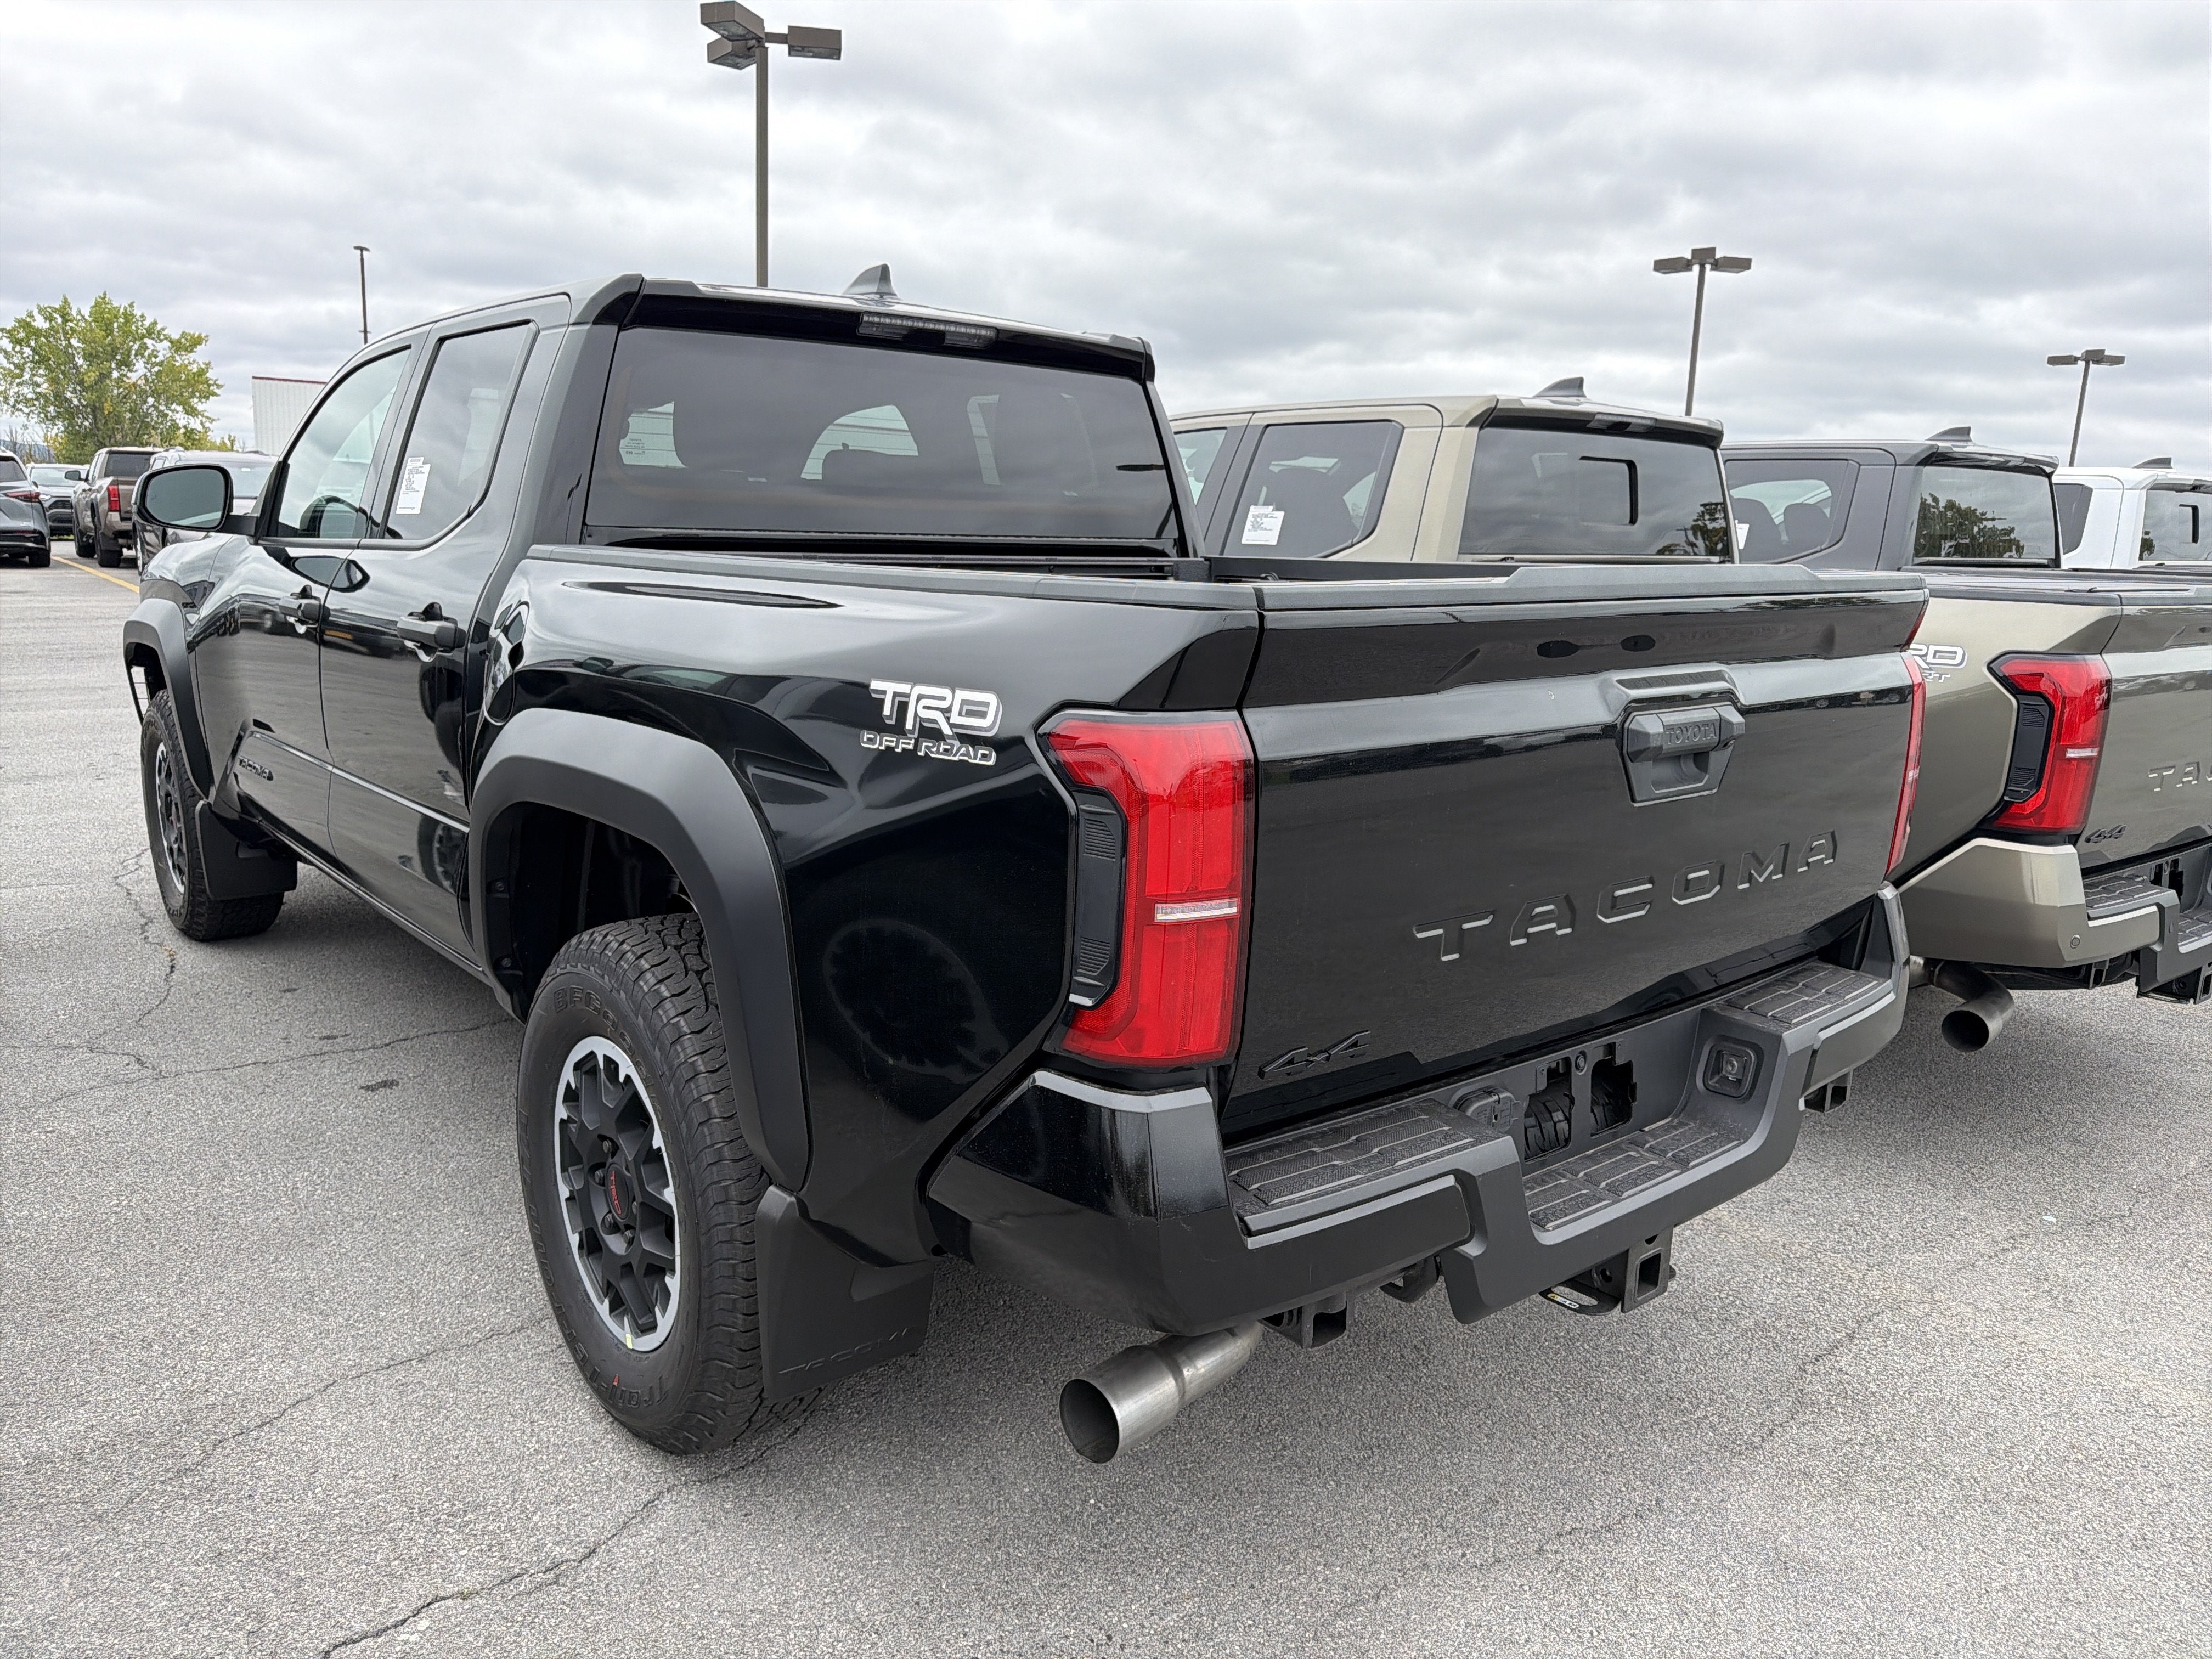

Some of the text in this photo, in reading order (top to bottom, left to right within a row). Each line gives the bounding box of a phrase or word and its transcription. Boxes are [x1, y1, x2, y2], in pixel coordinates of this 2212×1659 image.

[1909, 643, 1967, 669] RD
[869, 679, 1002, 742] TRD
[860, 730, 997, 766] OFF ROAD
[1666, 723, 1717, 745] TOYOTA
[1413, 830, 1837, 962] TACOMA
[610, 1170, 622, 1215] TRD
